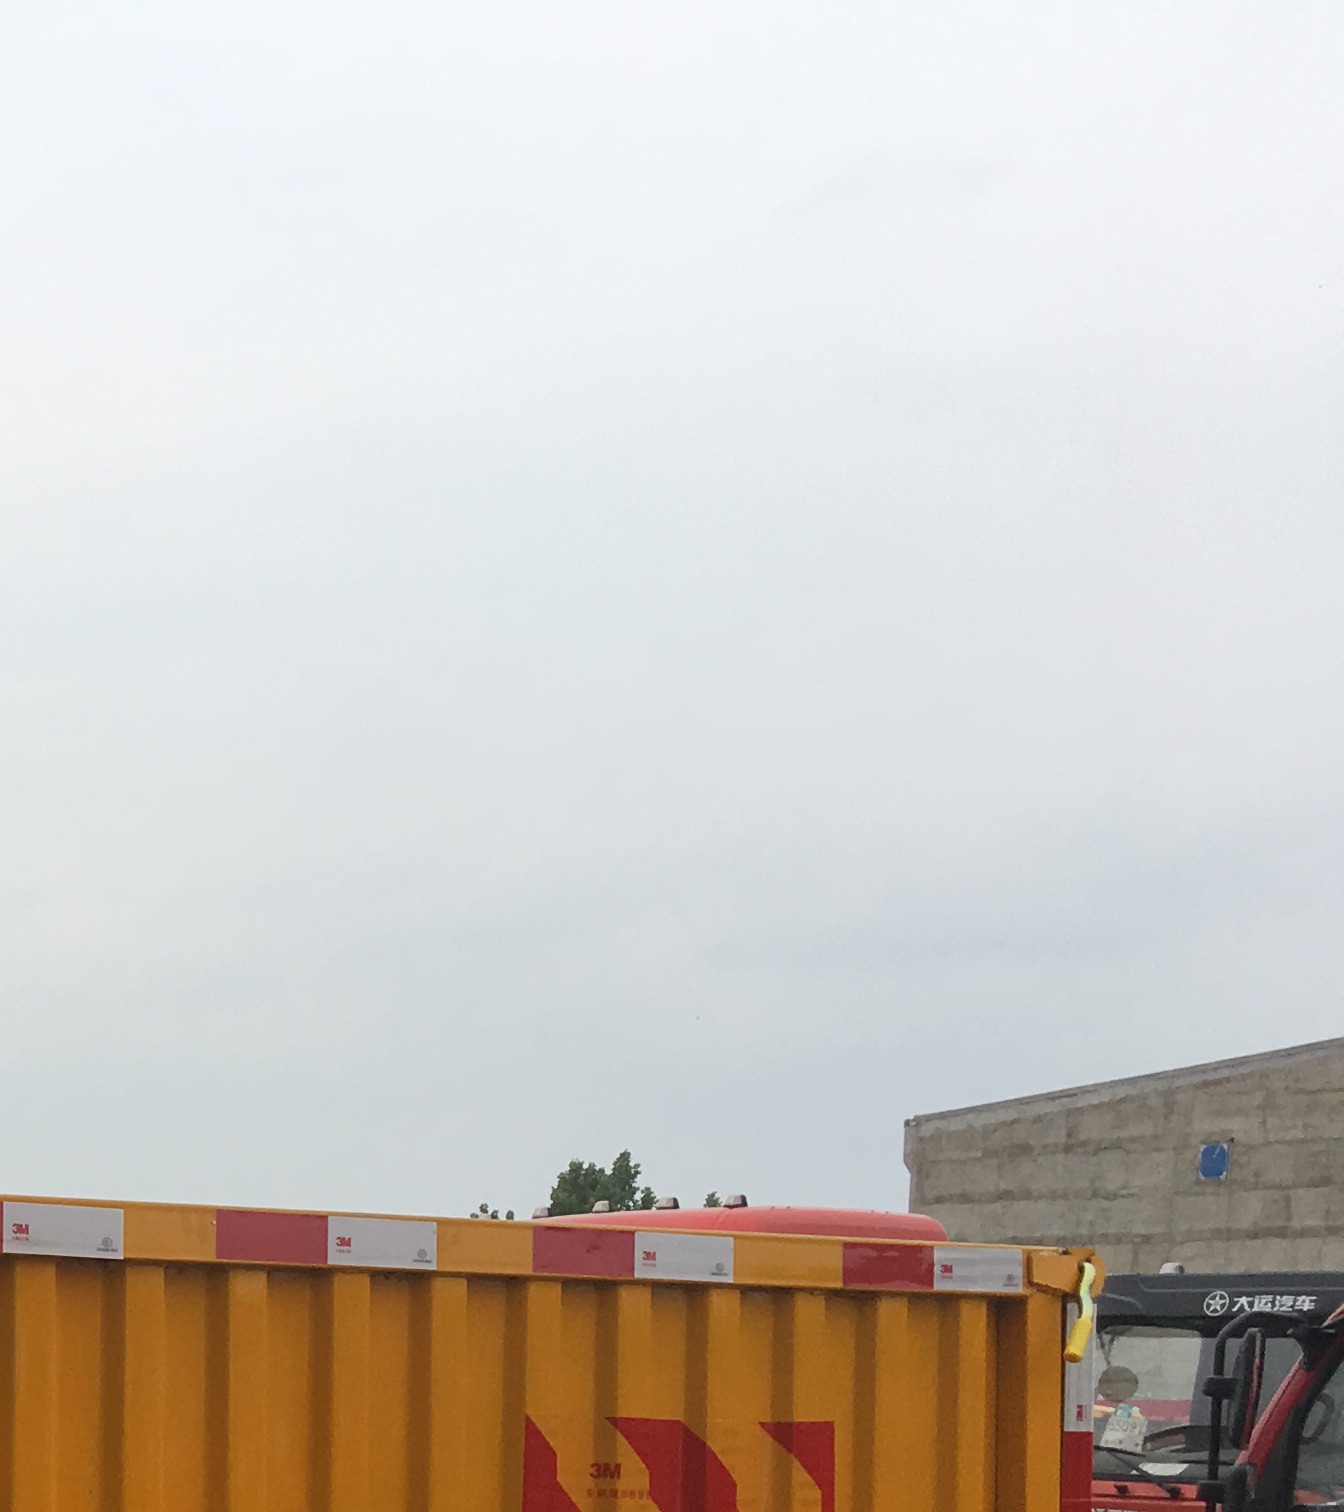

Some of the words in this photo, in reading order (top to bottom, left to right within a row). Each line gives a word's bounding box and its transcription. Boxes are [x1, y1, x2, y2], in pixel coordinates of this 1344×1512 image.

[12, 1224, 29, 1235] 3M
[336, 1237, 351, 1247] 3M
[642, 1252, 656, 1261] 3M
[1232, 1295, 1317, 1312] 大运汽车
[589, 1462, 621, 1480] 3M
